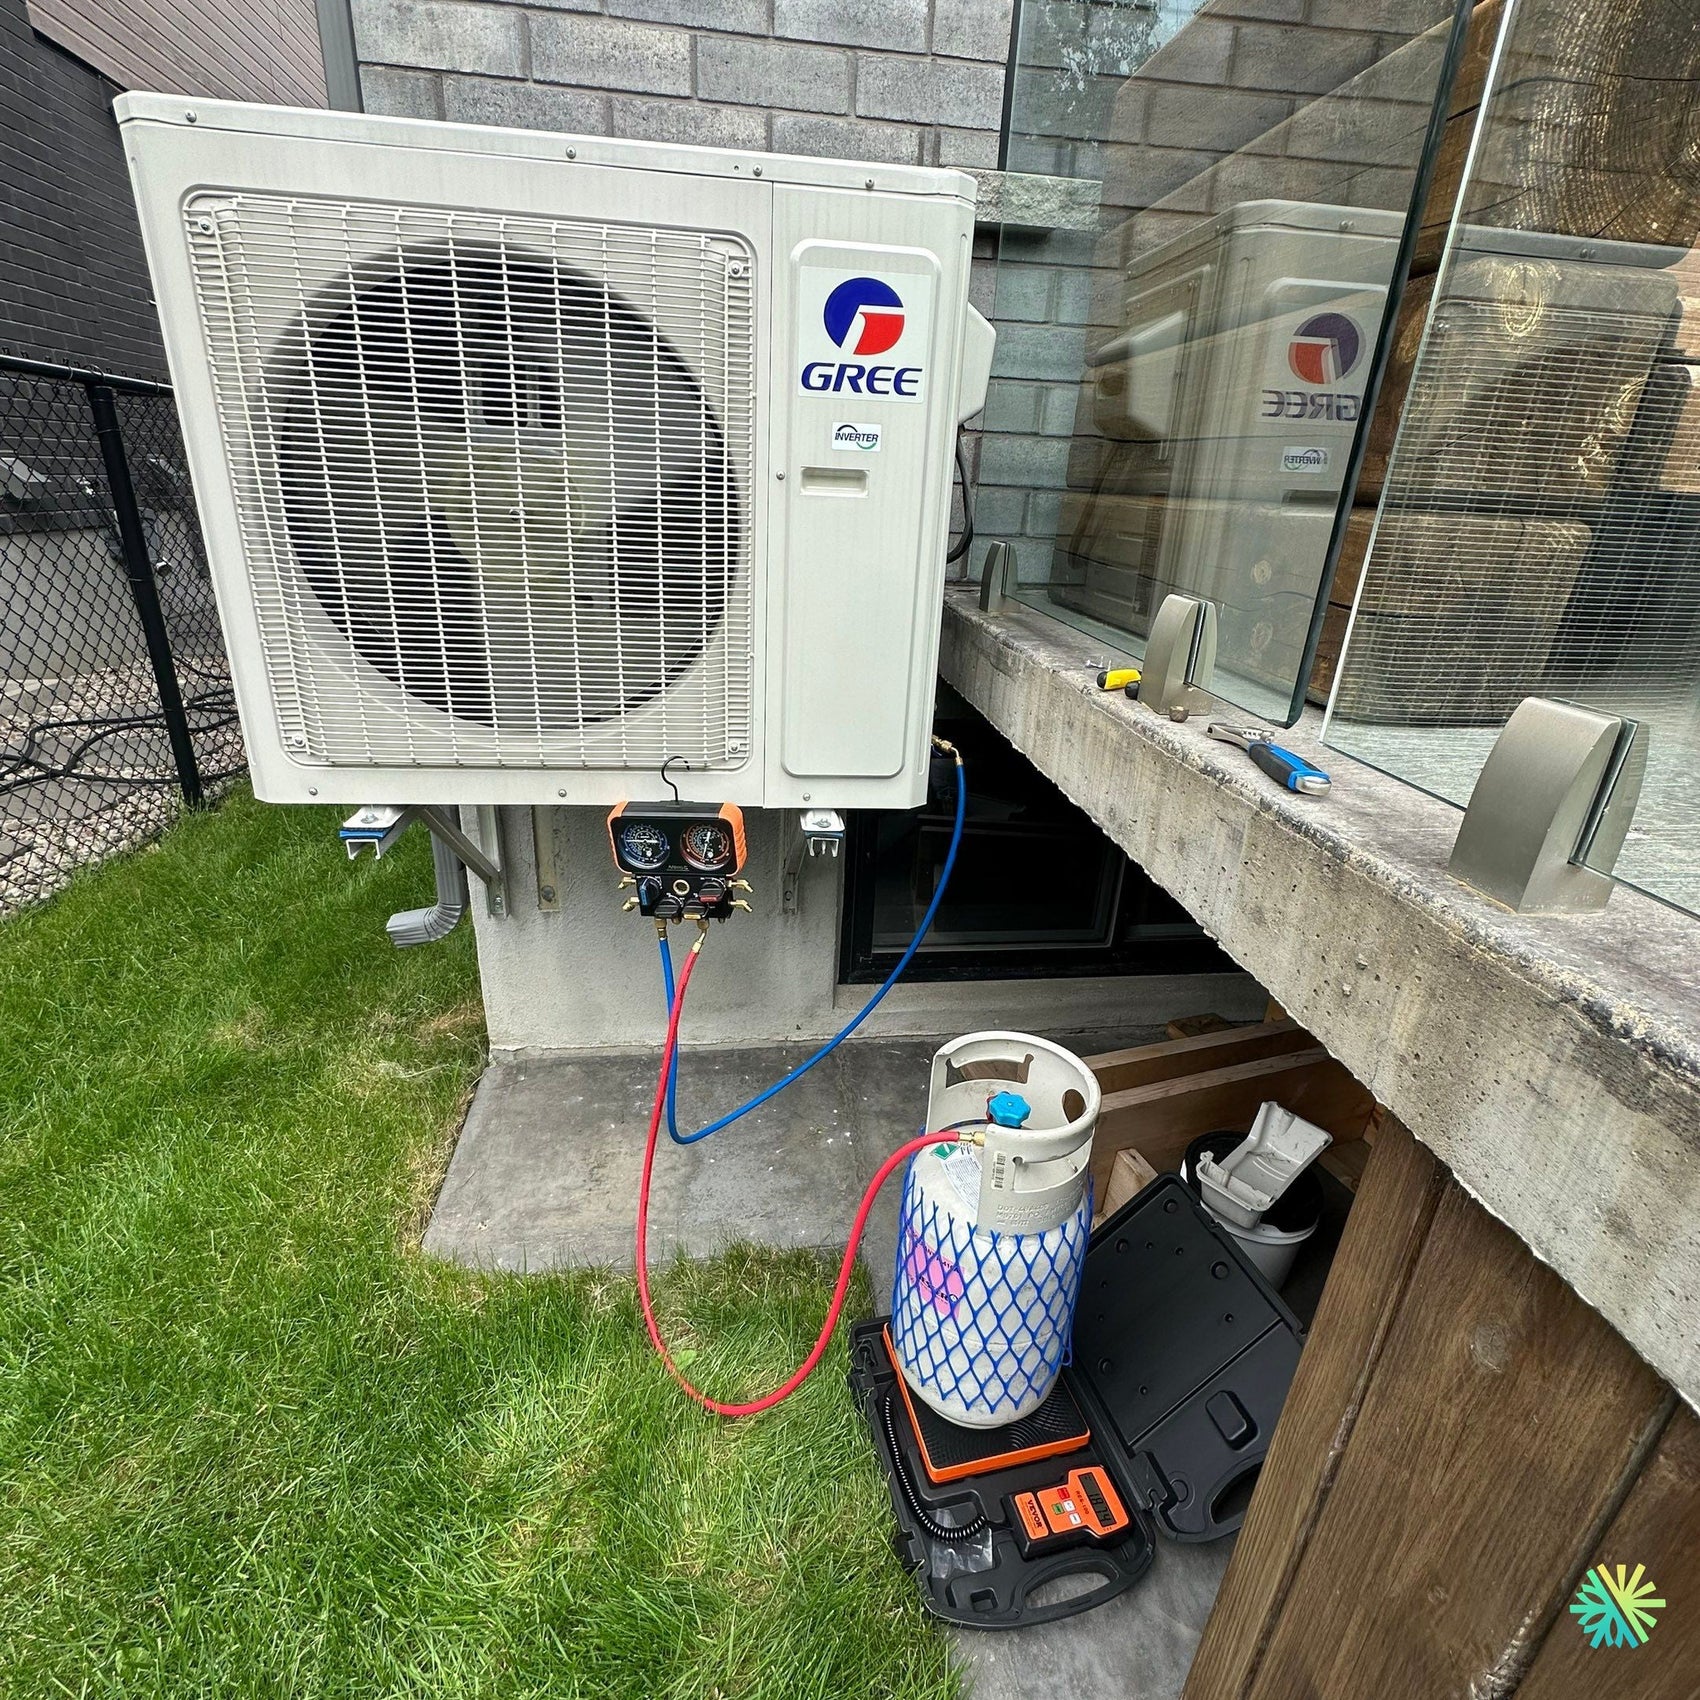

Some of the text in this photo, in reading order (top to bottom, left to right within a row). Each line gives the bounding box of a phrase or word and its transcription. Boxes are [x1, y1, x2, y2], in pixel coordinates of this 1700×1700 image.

[801, 362, 922, 396] GREE
[835, 432, 878, 442] INVERTER
[1027, 1499, 1043, 1528] VEVOR
